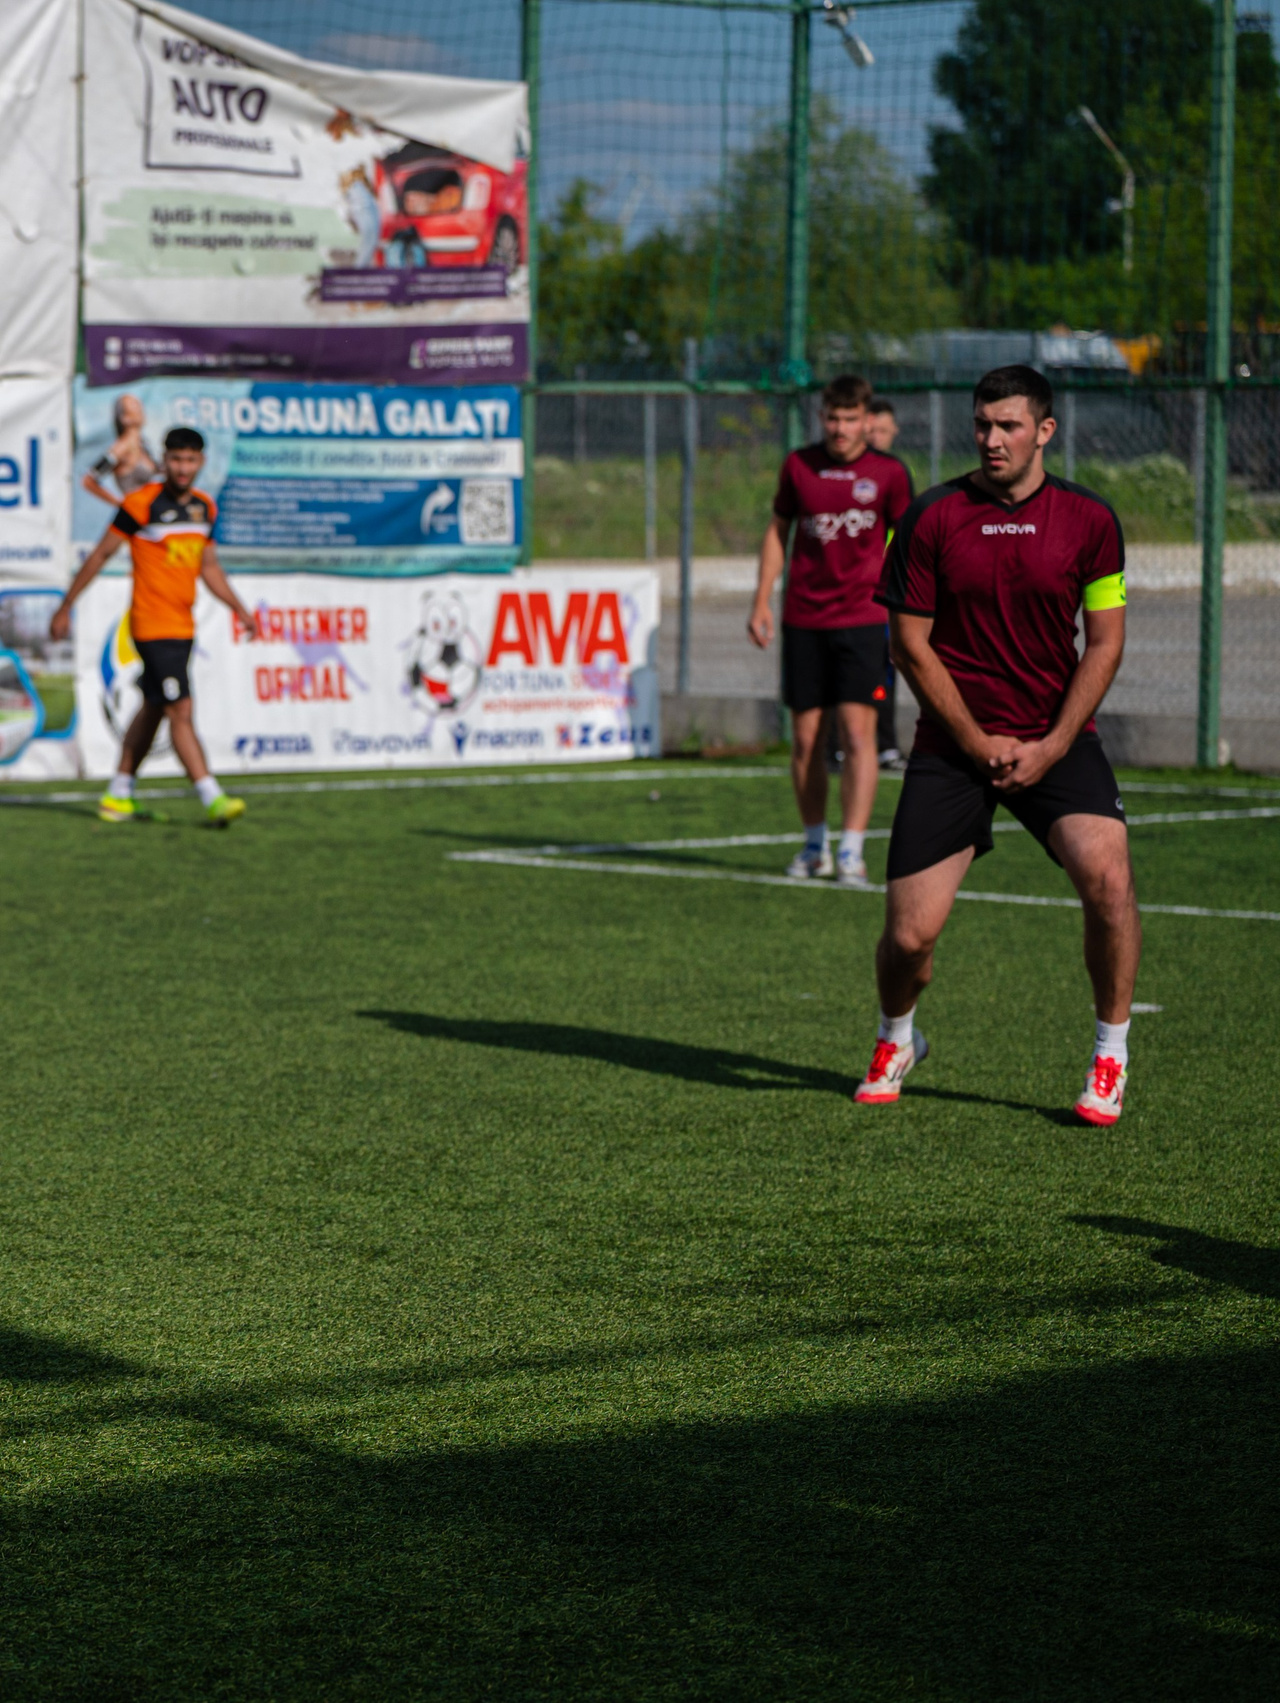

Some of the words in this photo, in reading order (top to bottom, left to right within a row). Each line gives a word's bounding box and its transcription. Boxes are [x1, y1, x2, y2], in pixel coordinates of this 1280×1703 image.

[172, 79, 268, 124] AUTO
[981, 523, 1036, 535] GIVOVA
[232, 605, 368, 645] PARTENER
[487, 592, 629, 667] AMA
[255, 666, 352, 703] OFICIAL
